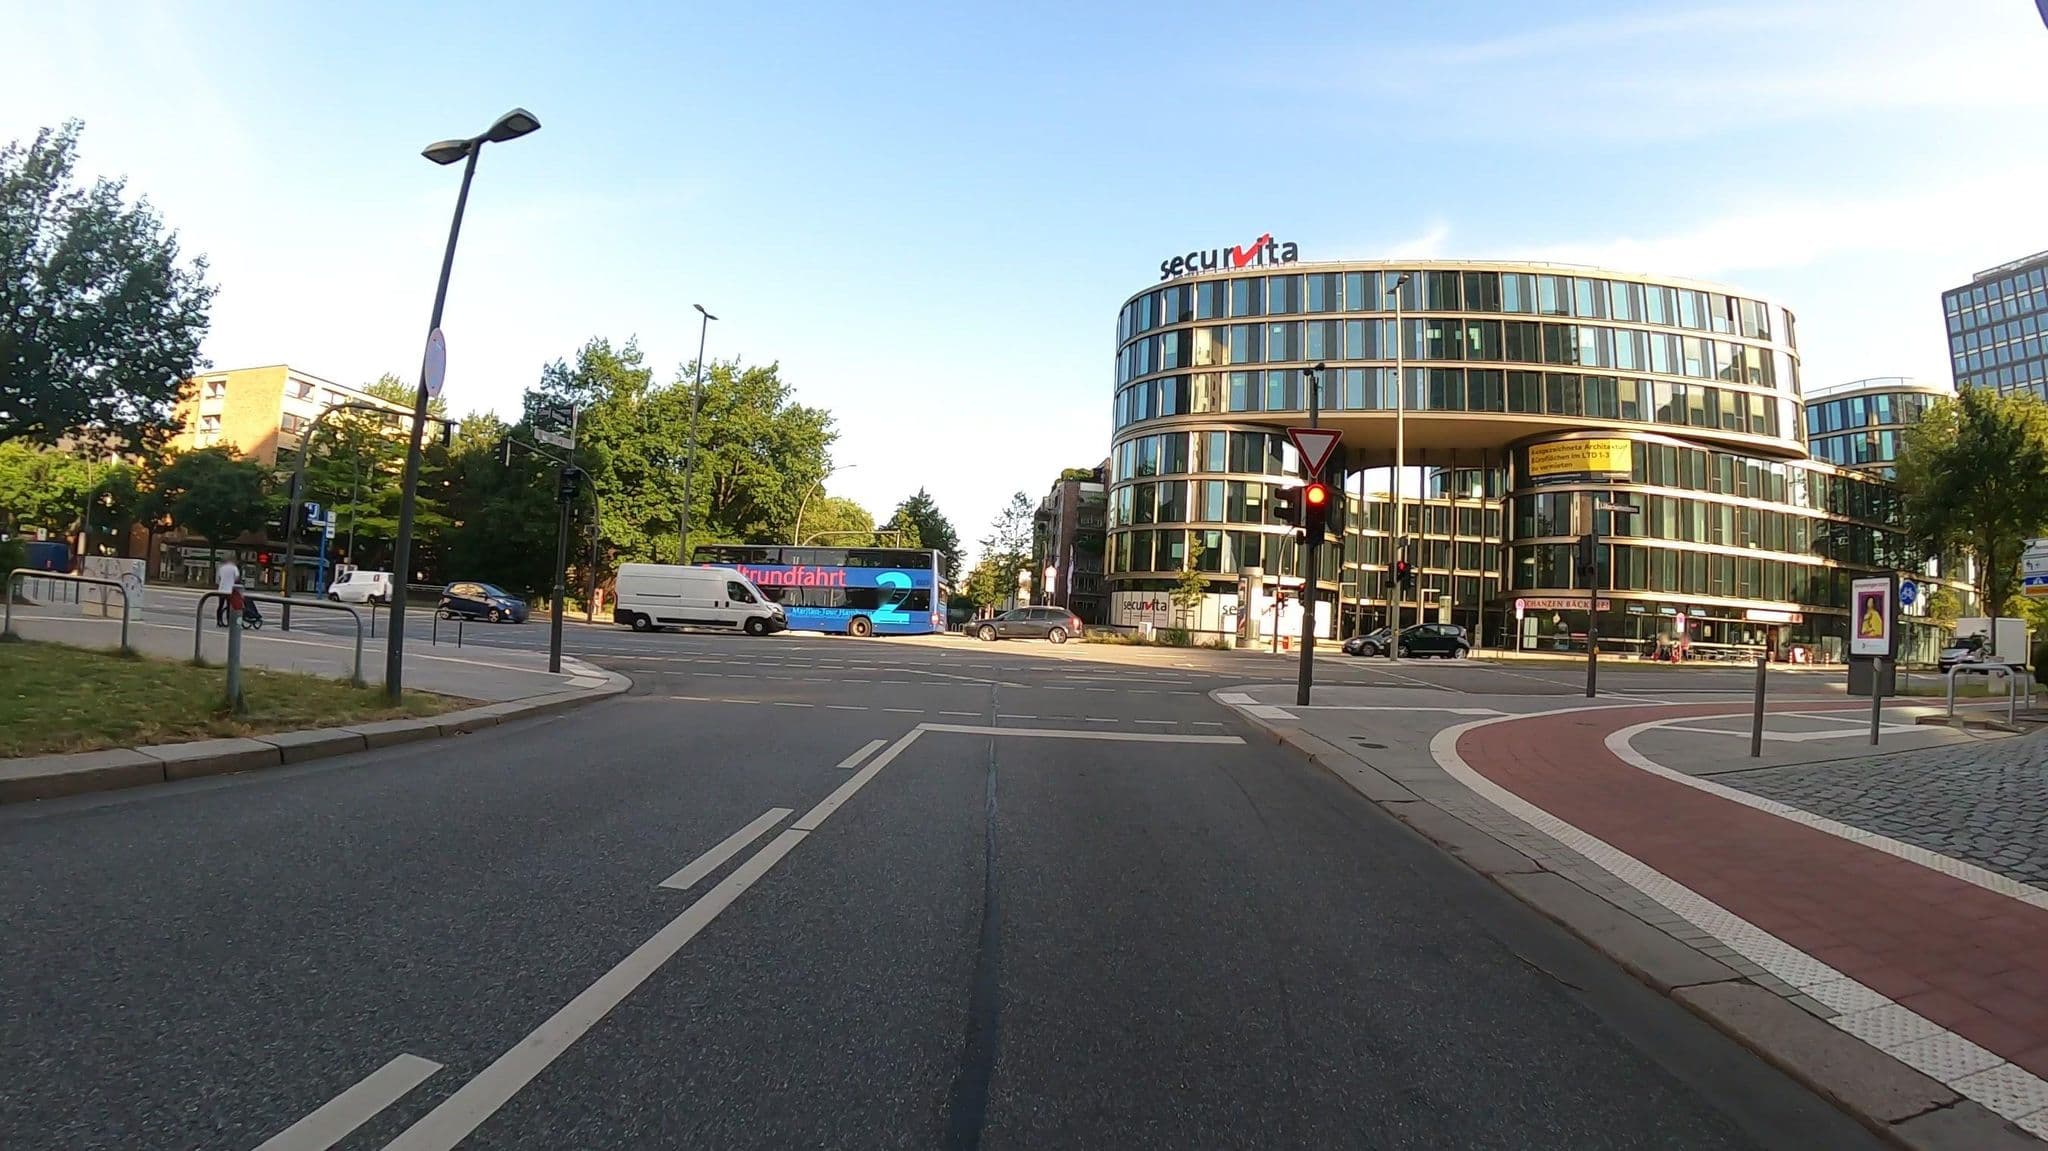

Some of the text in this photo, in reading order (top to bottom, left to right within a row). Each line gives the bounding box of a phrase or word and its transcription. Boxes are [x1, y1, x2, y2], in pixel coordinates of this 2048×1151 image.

[1160, 233, 1298, 280] securvita
[735, 564, 846, 587] trundfahrt
[876, 571, 913, 624] 2
[1123, 599, 1167, 612] securvita
